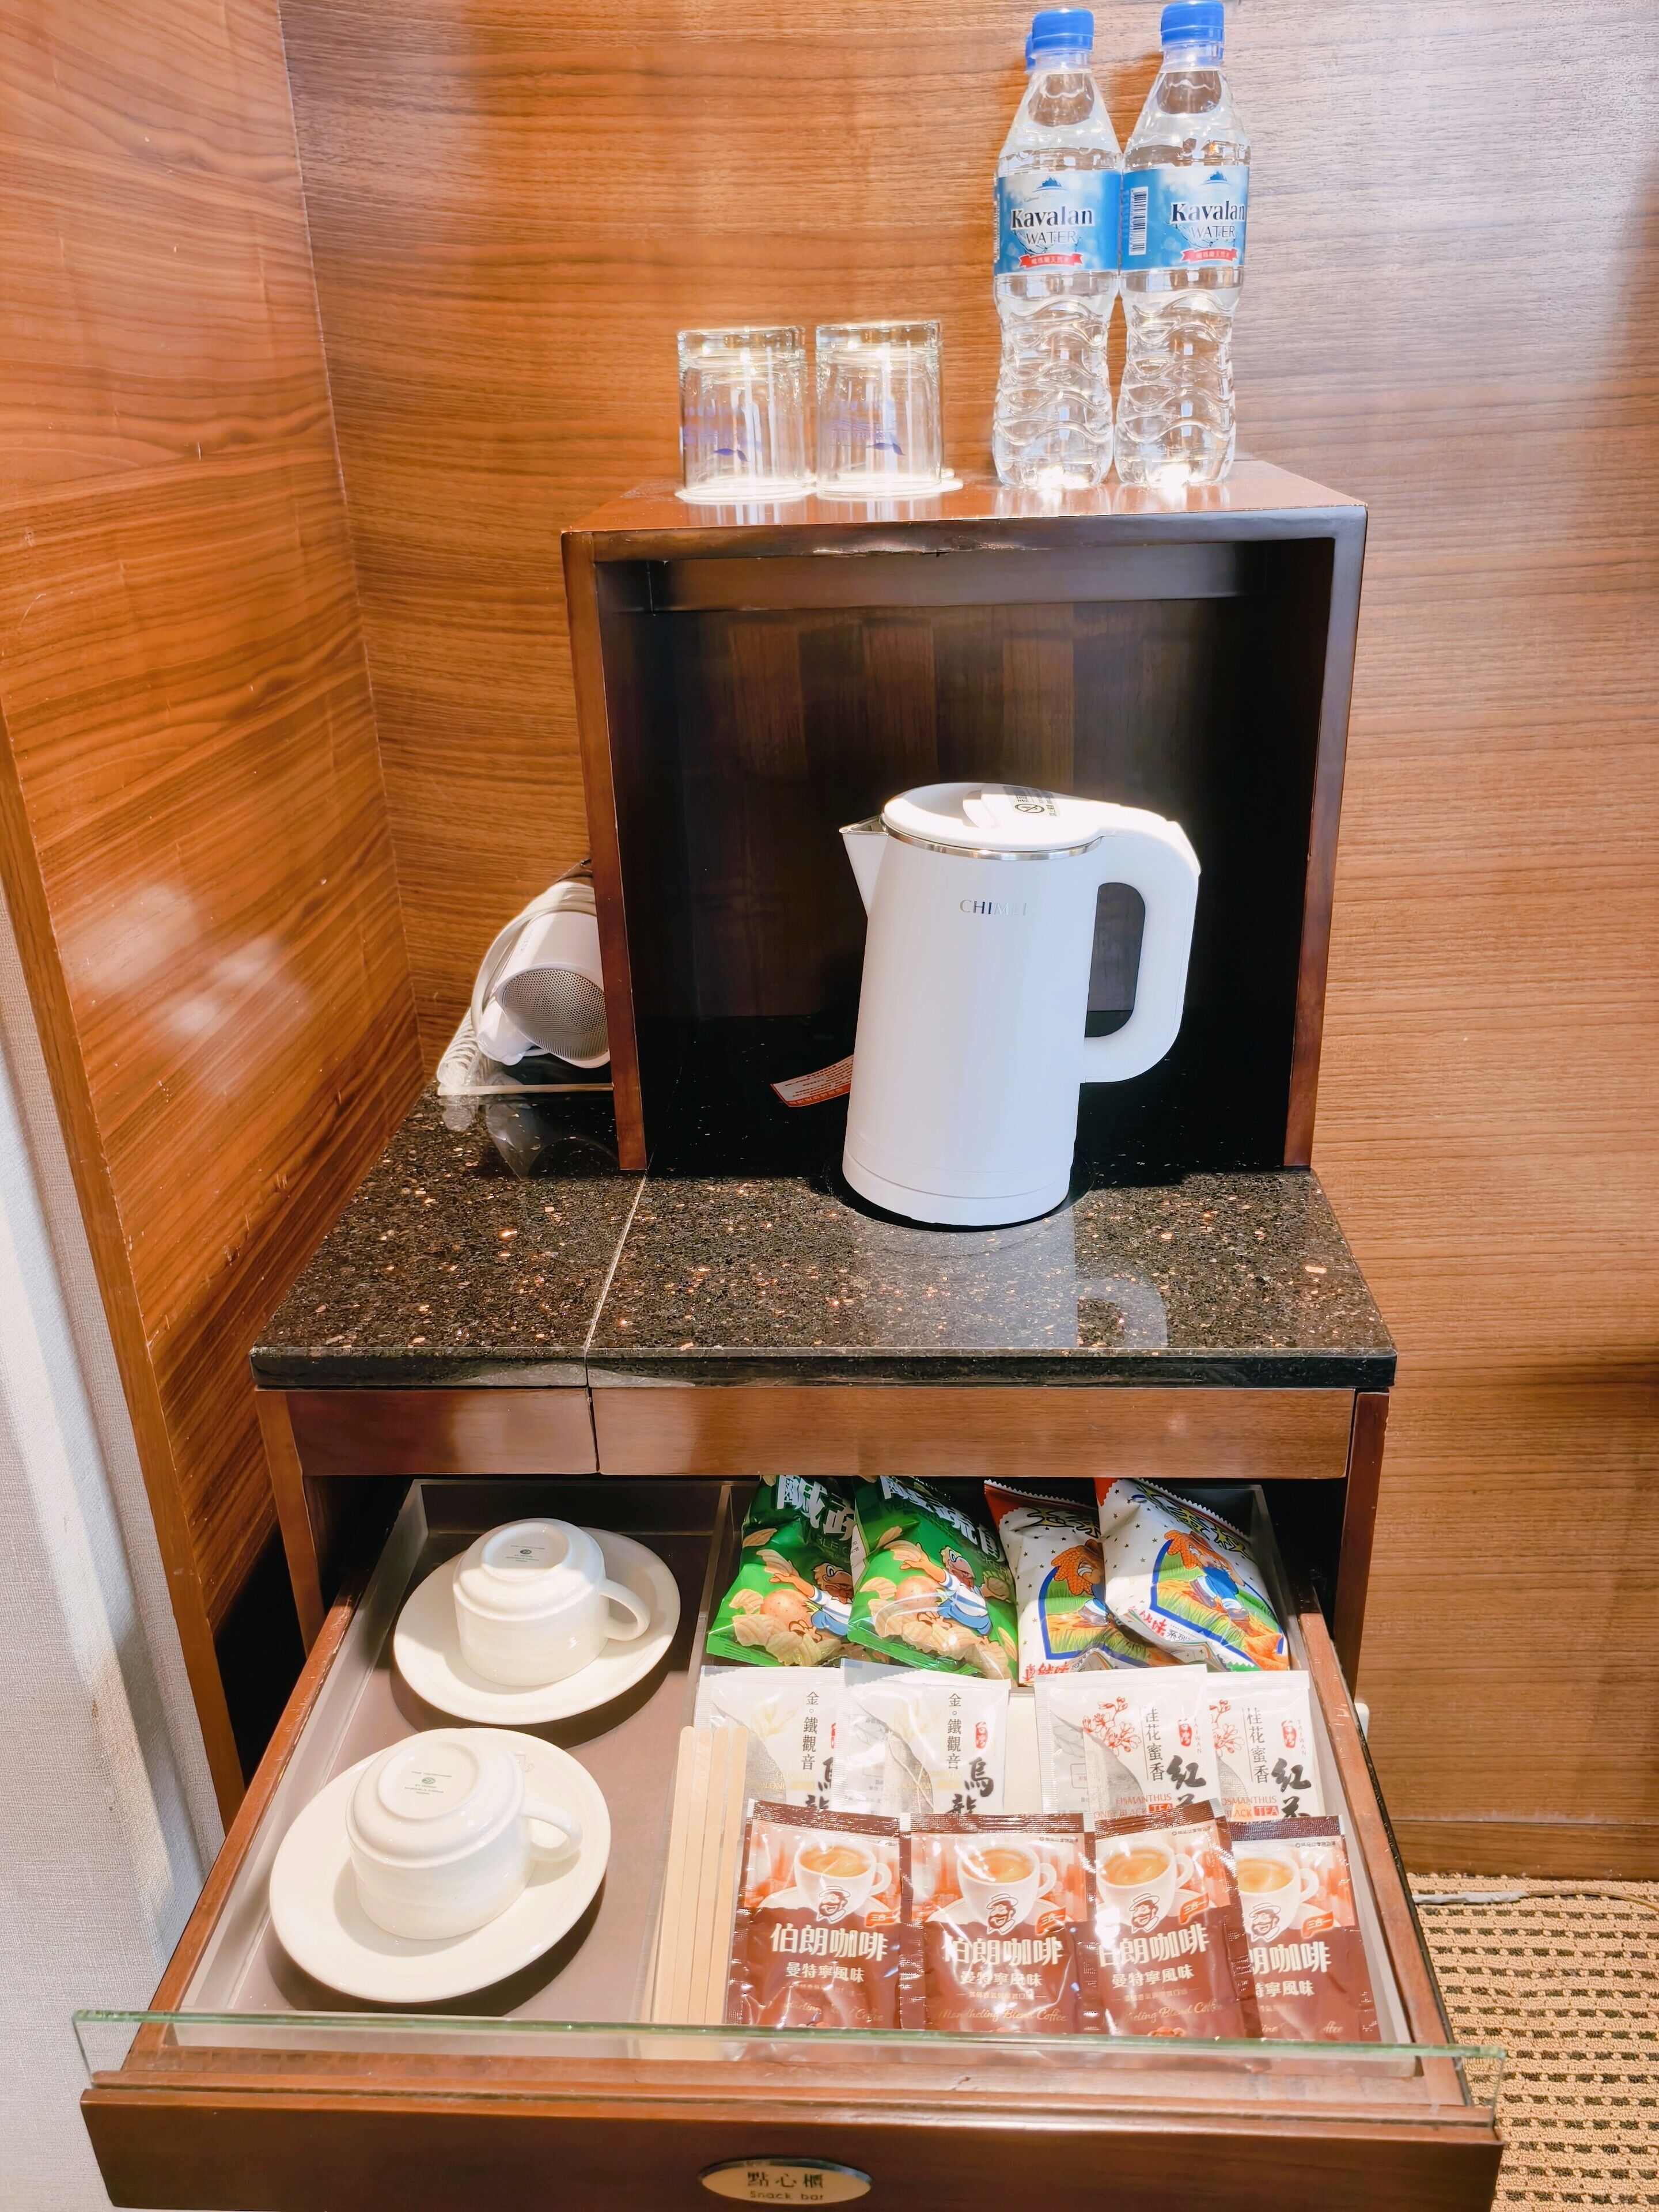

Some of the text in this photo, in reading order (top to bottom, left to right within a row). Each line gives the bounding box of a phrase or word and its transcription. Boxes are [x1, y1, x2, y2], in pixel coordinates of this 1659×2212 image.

[1012, 206, 1092, 228] Kavalan
[1172, 200, 1244, 222] Kavalan
[1026, 231, 1075, 245] WATER
[1191, 225, 1235, 238] WATER
[960, 899, 1027, 916] CHIMEI
[1247, 1707, 1270, 1784] 桂花蜜香
[1152, 1804, 1173, 1812] TEA
[1221, 1796, 1277, 1806] OSMANTHUS
[1256, 1806, 1279, 1815] TEA
[1184, 1900, 1208, 1912] 三合一
[1308, 1918, 1332, 1927] 三合一
[770, 1922, 889, 1961] 伯朗咖啡
[941, 1937, 1064, 1966] 伯朗咖啡
[785, 1961, 865, 1983] 曼特寧風味
[1112, 1964, 1195, 1988] 曼特寧風味
[750, 2191, 823, 2200] Snack bar
